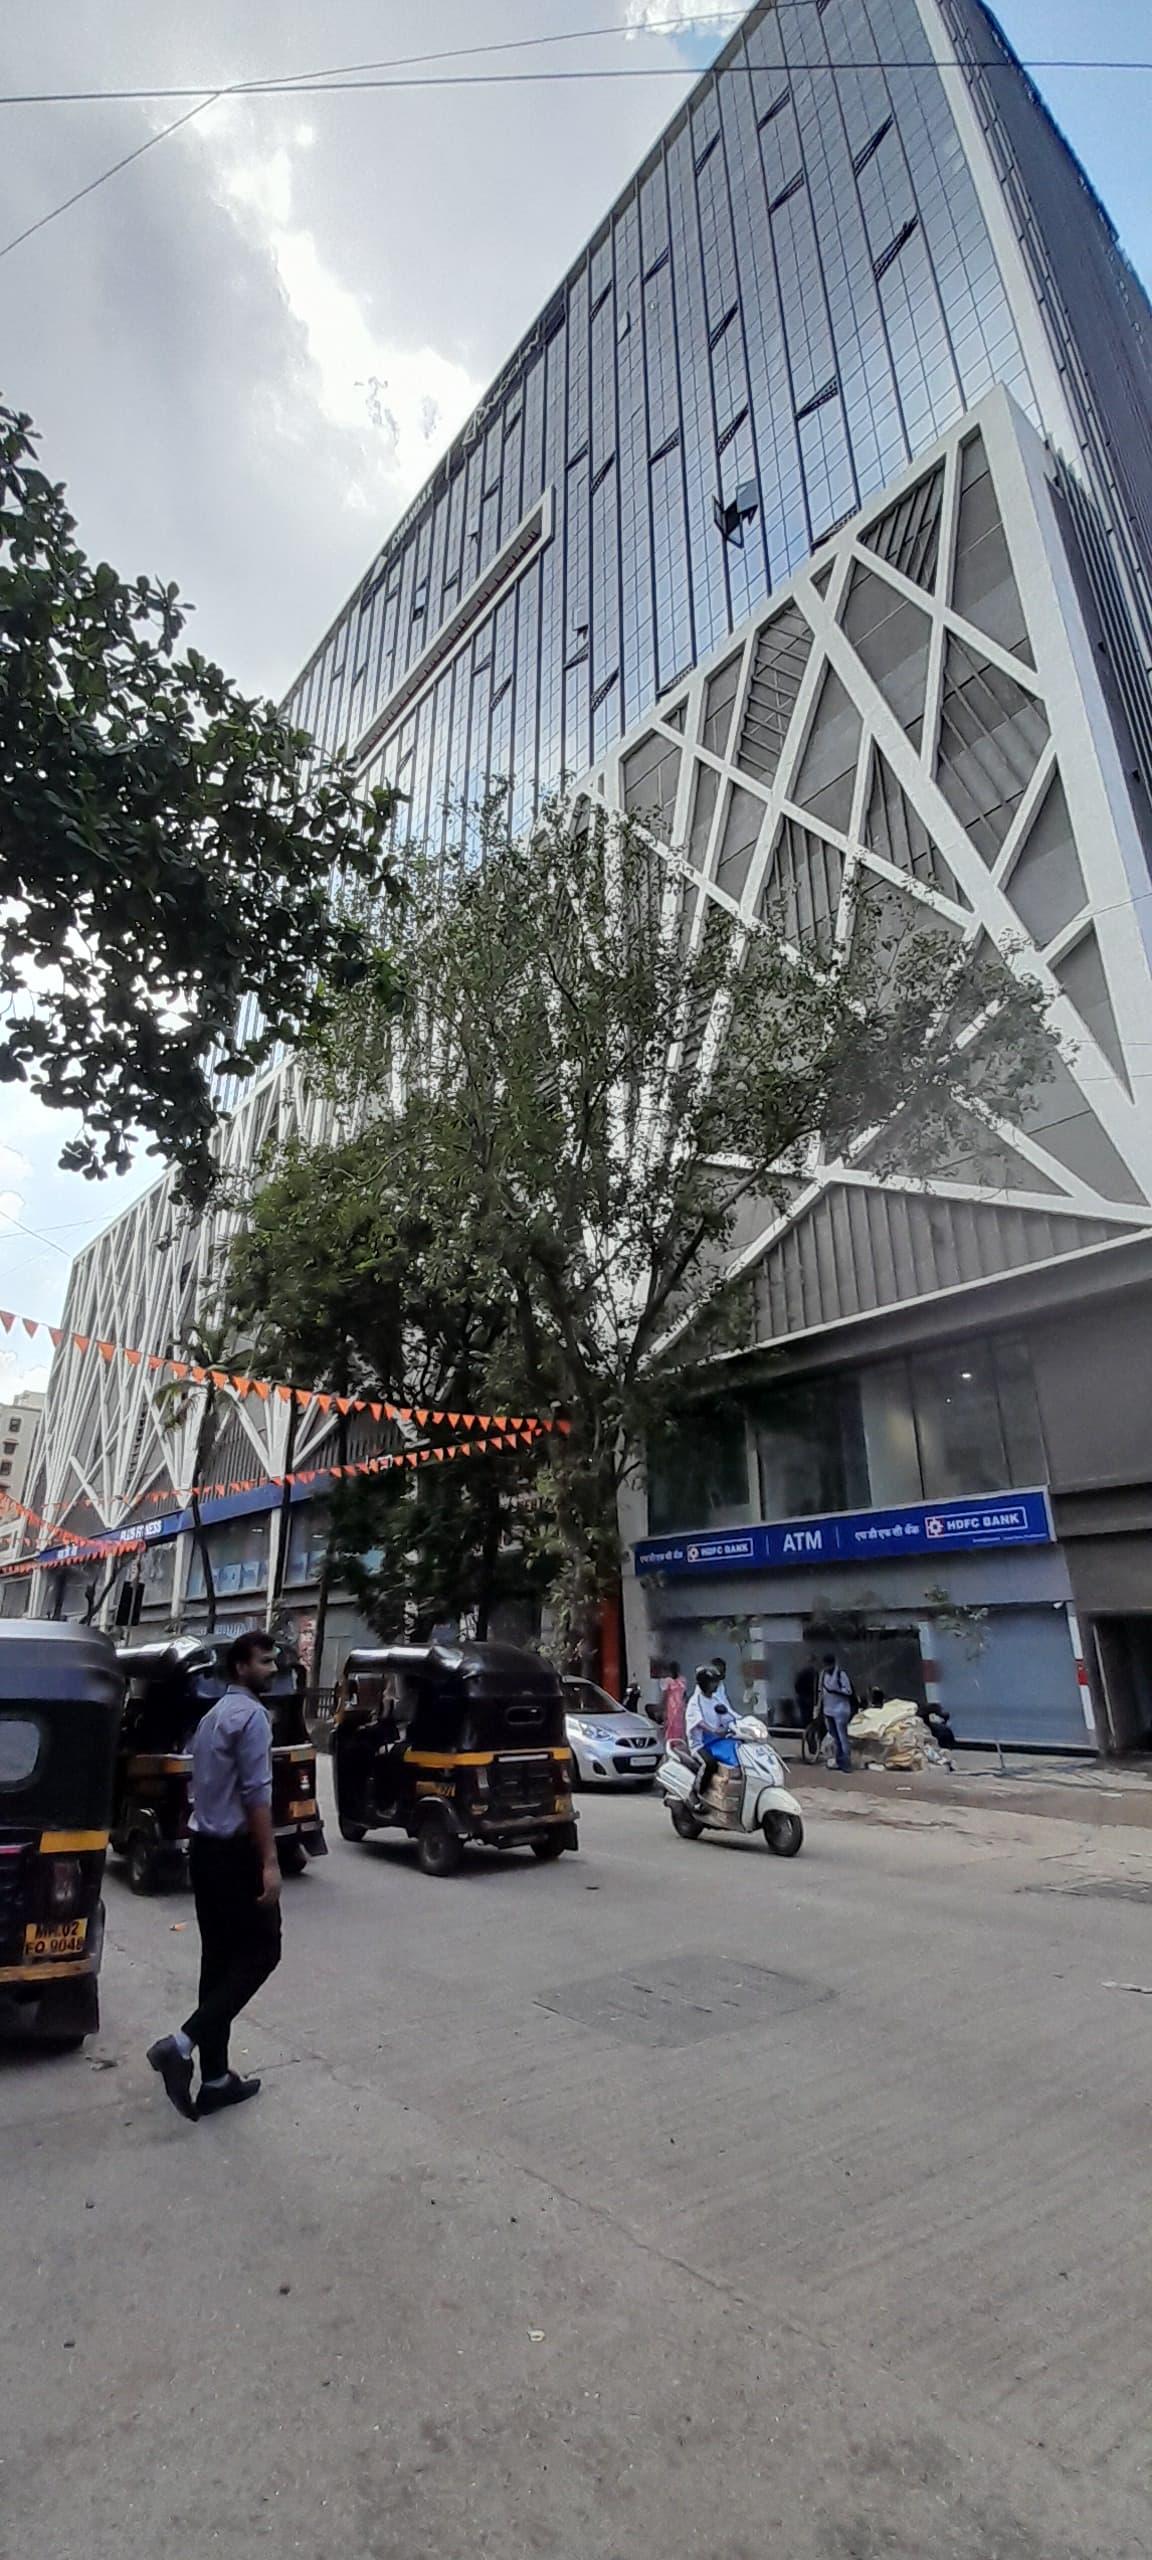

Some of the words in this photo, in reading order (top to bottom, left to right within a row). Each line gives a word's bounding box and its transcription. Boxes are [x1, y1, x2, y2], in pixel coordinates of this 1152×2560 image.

[946, 1517, 981, 1532] HDFC
[982, 1512, 1019, 1528] BANK
[724, 1543, 748, 1554] BANK
[783, 1530, 823, 1552] ATM
